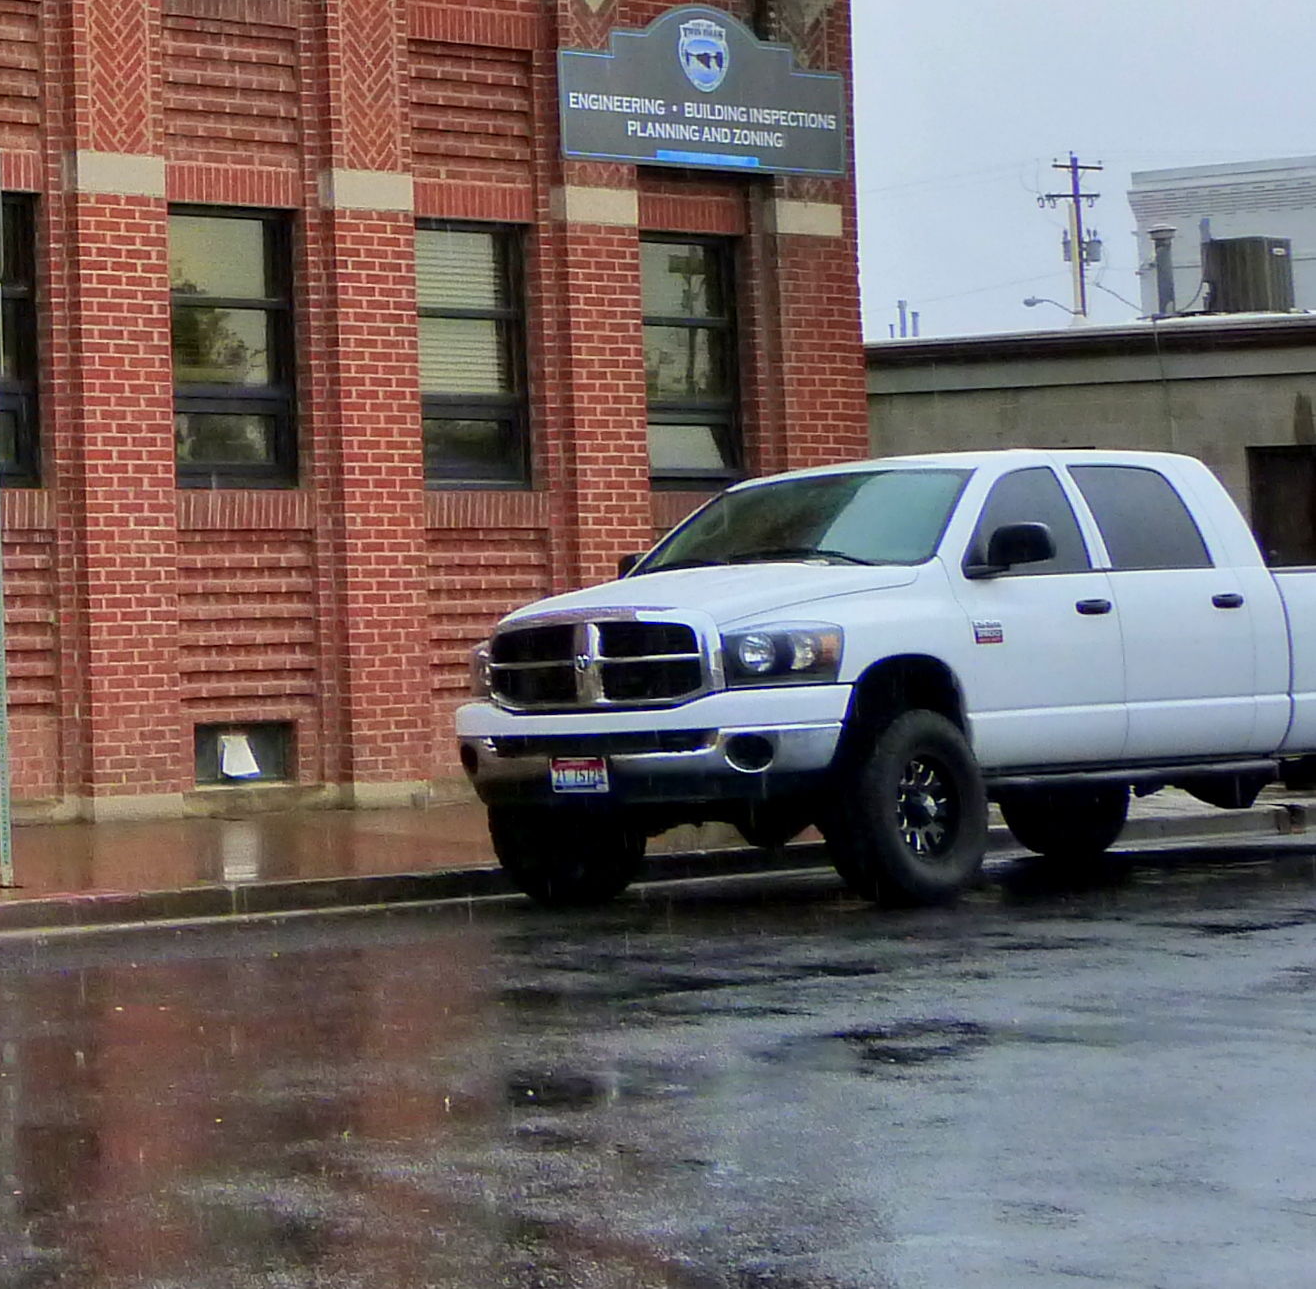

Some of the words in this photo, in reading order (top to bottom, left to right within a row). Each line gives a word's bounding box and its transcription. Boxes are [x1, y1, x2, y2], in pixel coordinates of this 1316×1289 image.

[568, 92, 665, 115] ENGINEERING
[684, 101, 747, 123] BUILDING
[749, 108, 837, 130] INSPECTIONS
[627, 120, 699, 141] PLANNING
[701, 126, 730, 144] AND
[733, 129, 784, 148] ZONING
